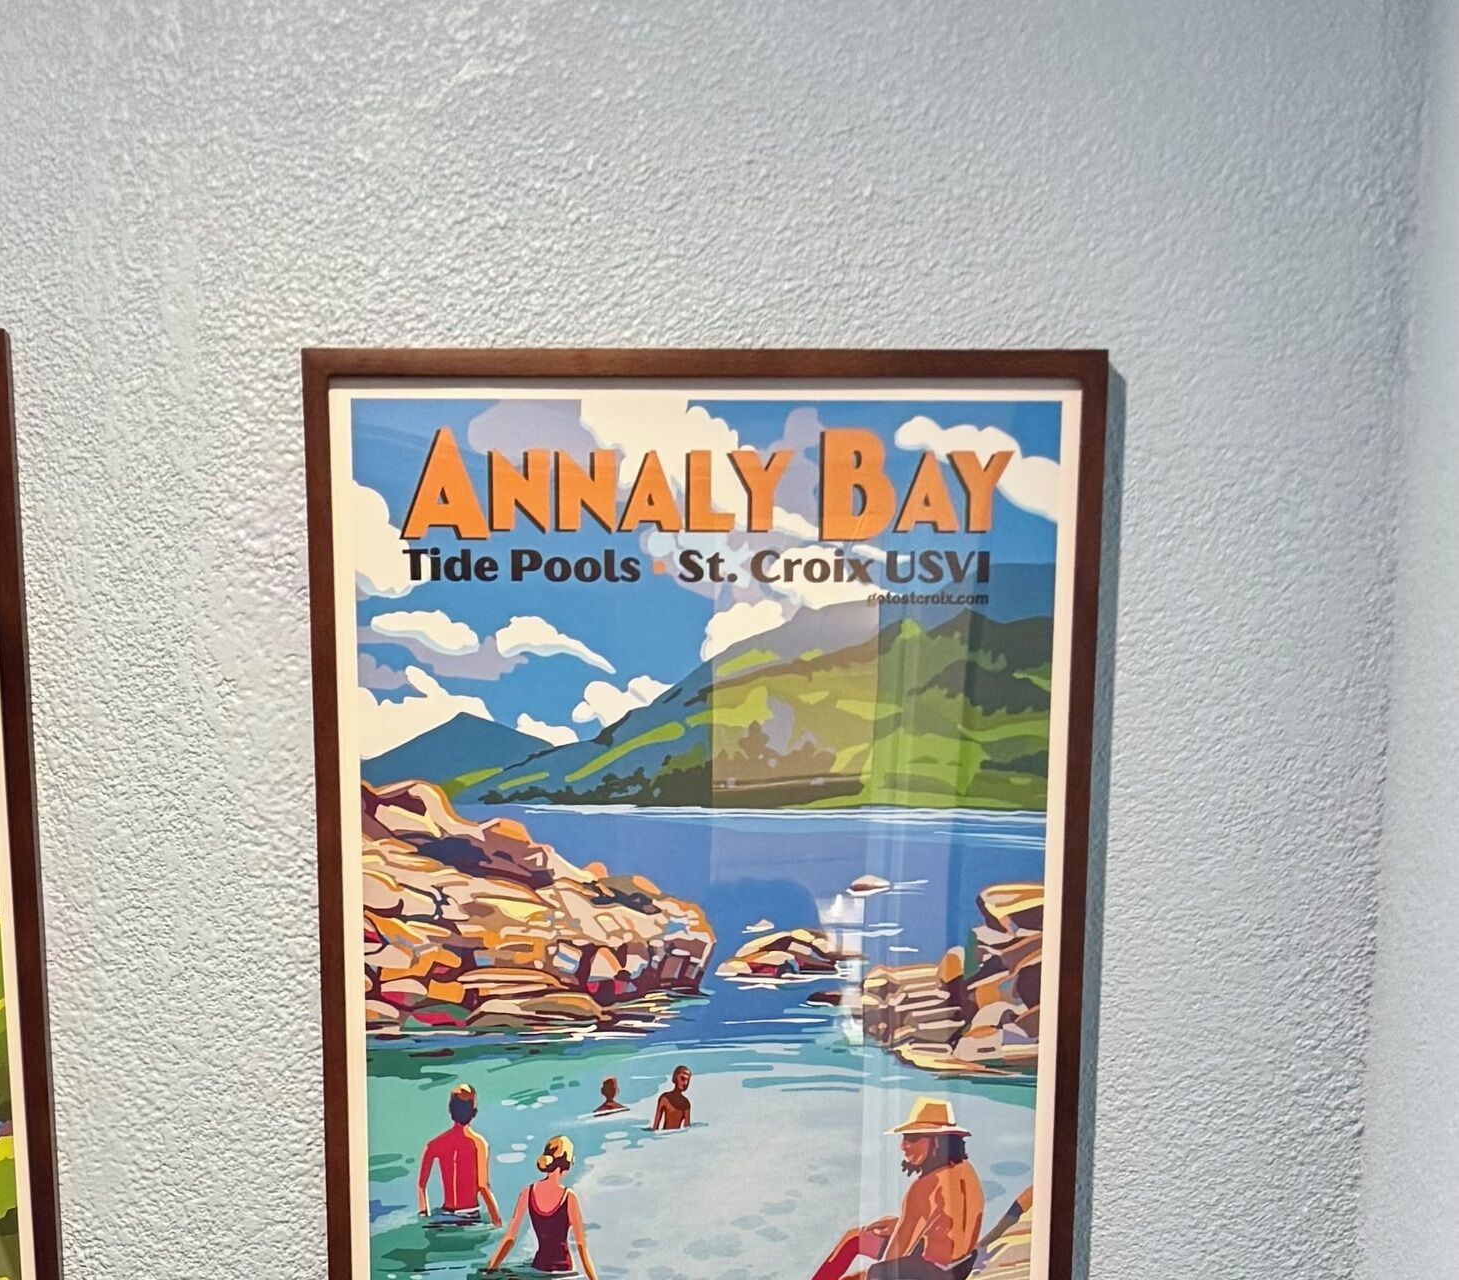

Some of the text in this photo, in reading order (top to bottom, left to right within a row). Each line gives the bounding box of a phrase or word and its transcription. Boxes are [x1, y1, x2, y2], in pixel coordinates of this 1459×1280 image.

[400, 425, 1016, 541] ANNALY BAY
[402, 547, 991, 583] Tide Pools St. Croix USVI
[867, 592, 990, 607] gotostcroix.com
